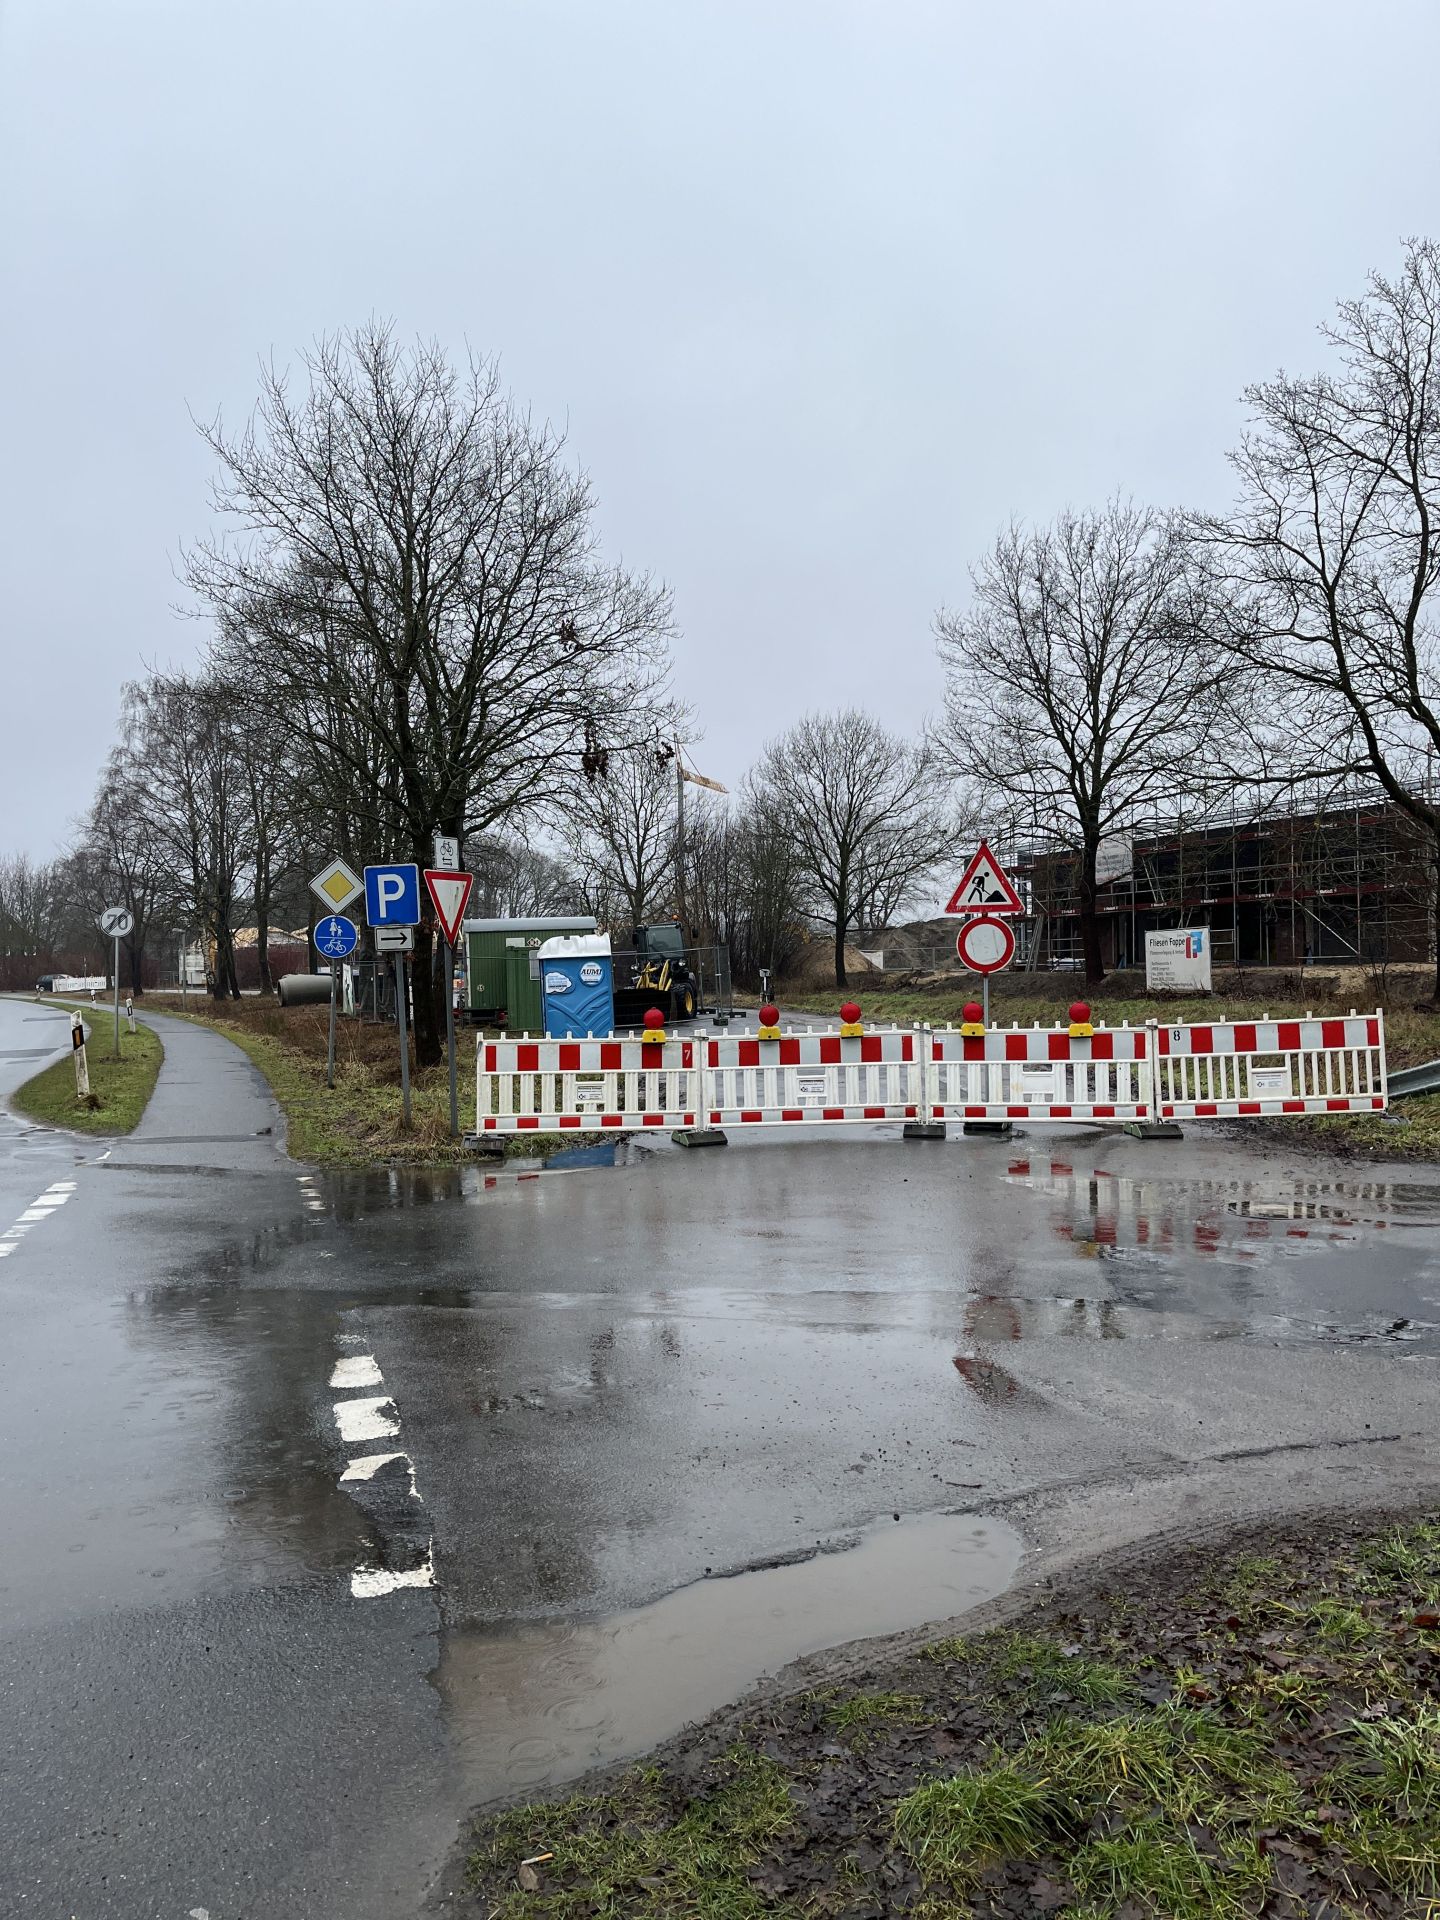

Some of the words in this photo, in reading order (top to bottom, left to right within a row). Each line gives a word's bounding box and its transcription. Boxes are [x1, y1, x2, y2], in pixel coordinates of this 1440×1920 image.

[377, 874, 405, 919] P
[107, 914, 128, 930] 70
[1149, 938, 1169, 947] Fliesen
[1173, 1030, 1181, 1042] 8
[684, 1049, 691, 1061] 7
